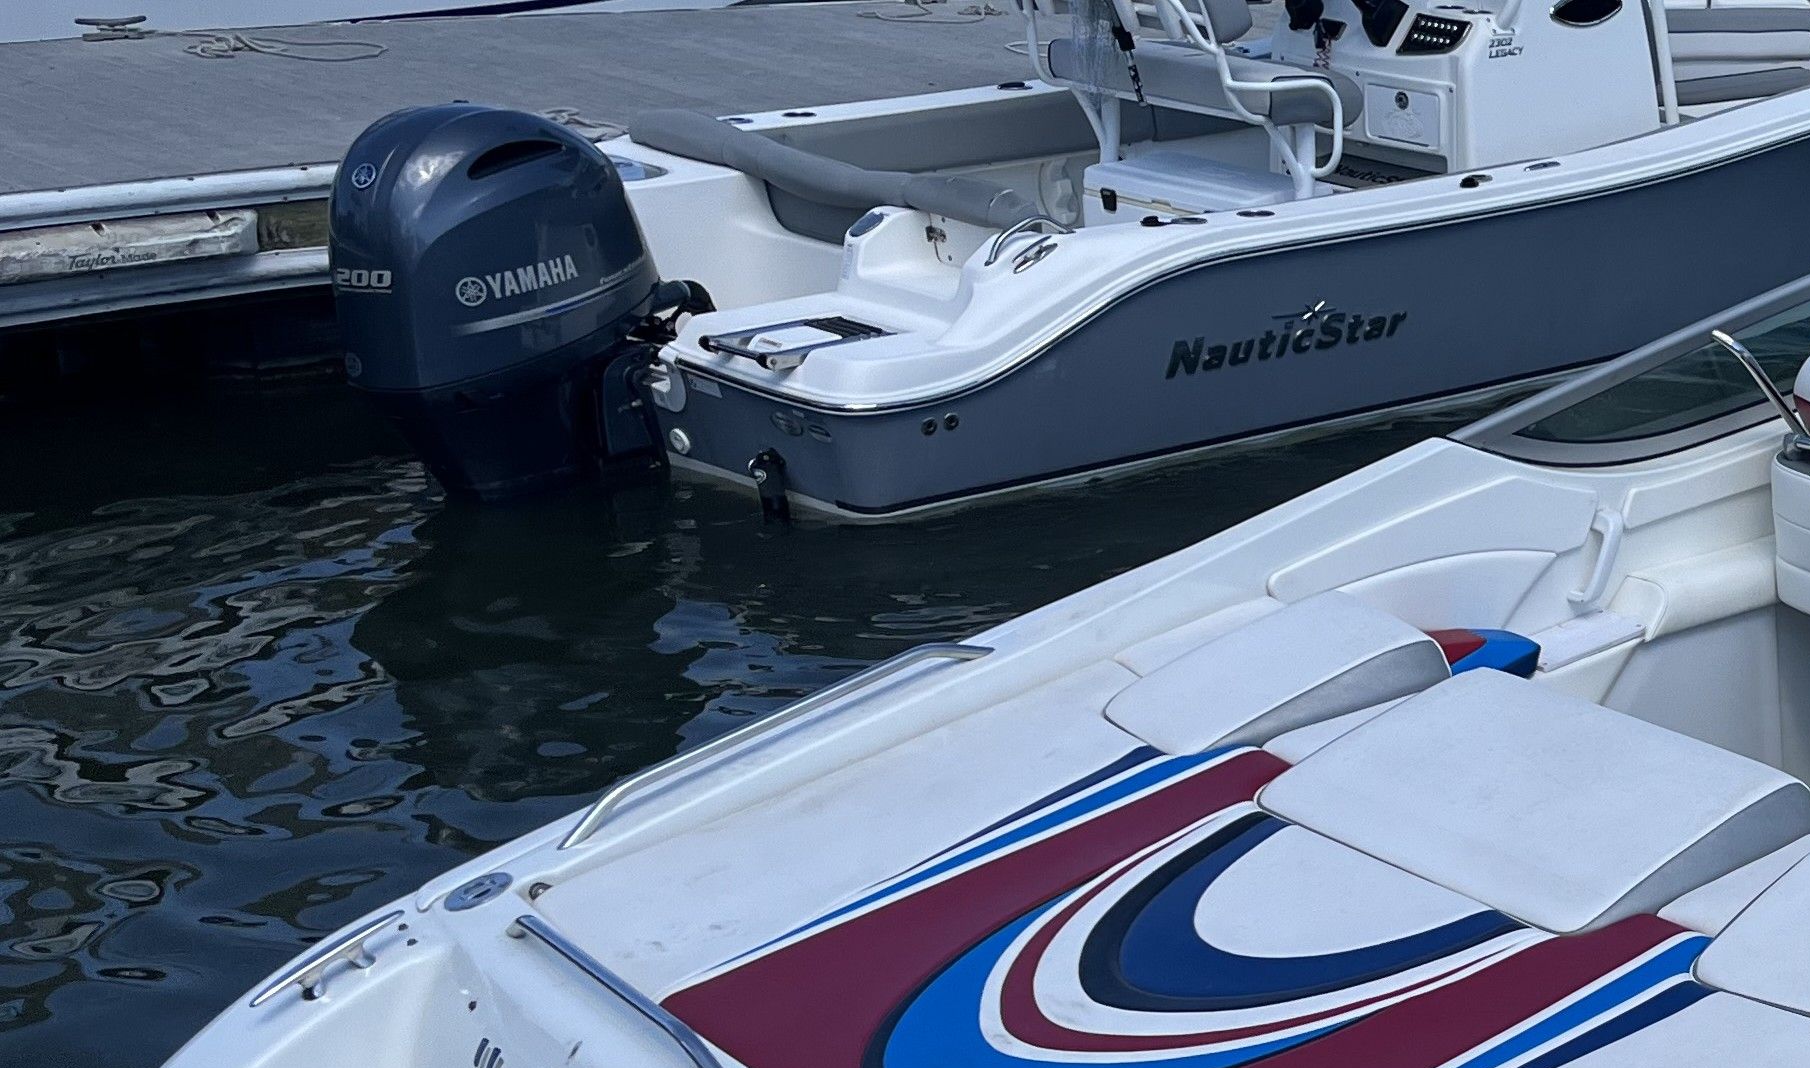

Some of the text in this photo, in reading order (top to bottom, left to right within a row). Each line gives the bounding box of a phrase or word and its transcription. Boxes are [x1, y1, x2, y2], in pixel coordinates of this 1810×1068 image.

[1488, 46, 1524, 59] LEGACY
[67, 252, 117, 271] Taylor
[335, 268, 392, 288] 200
[485, 254, 579, 299] YAMAHA
[1165, 311, 1407, 380] NauticStar
